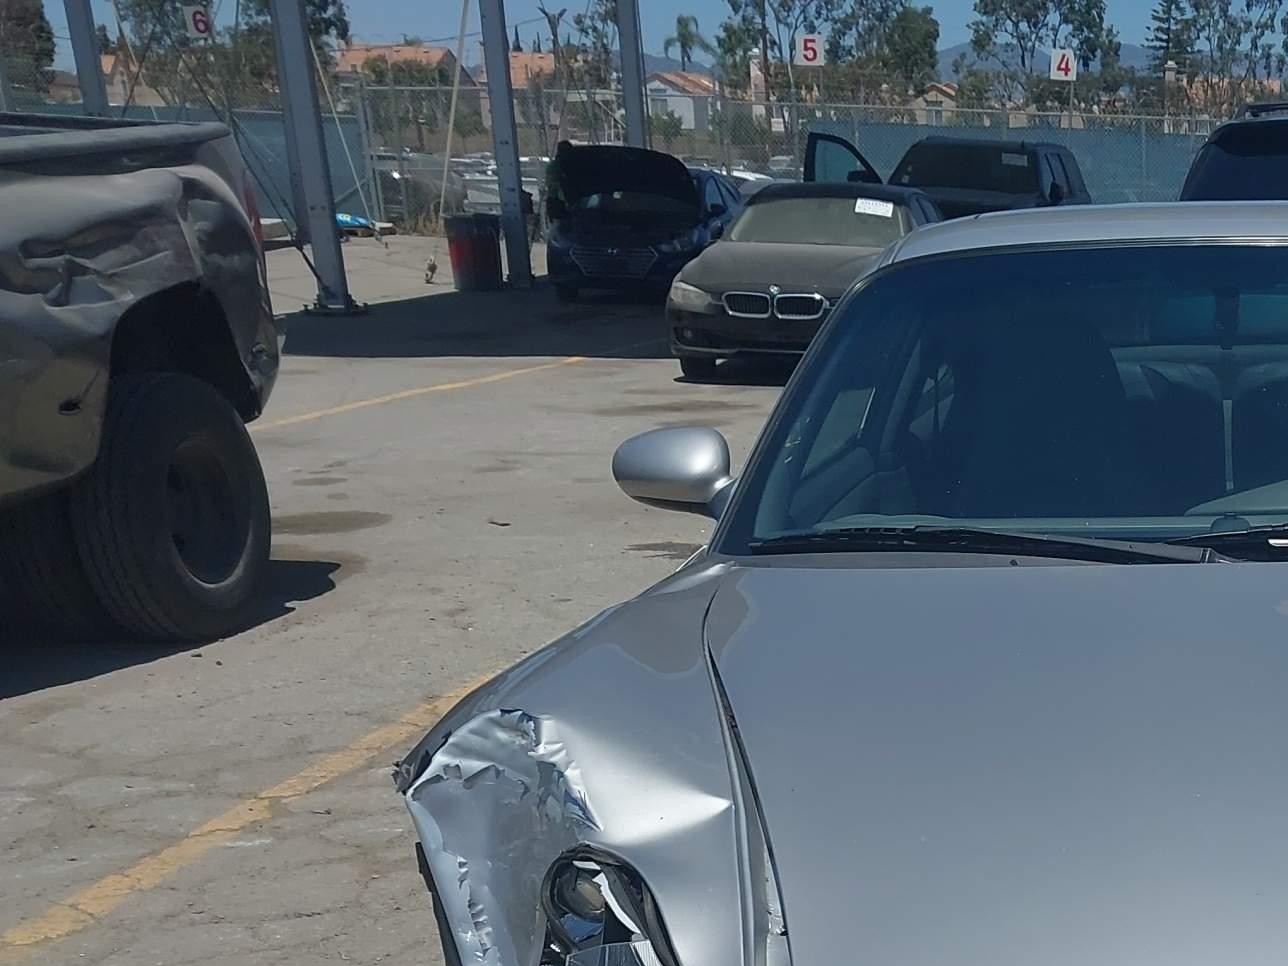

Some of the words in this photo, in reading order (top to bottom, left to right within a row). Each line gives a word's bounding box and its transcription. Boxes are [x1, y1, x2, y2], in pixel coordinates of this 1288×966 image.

[192, 10, 209, 33] 6
[803, 38, 818, 62] 5
[1056, 53, 1071, 77] 4
